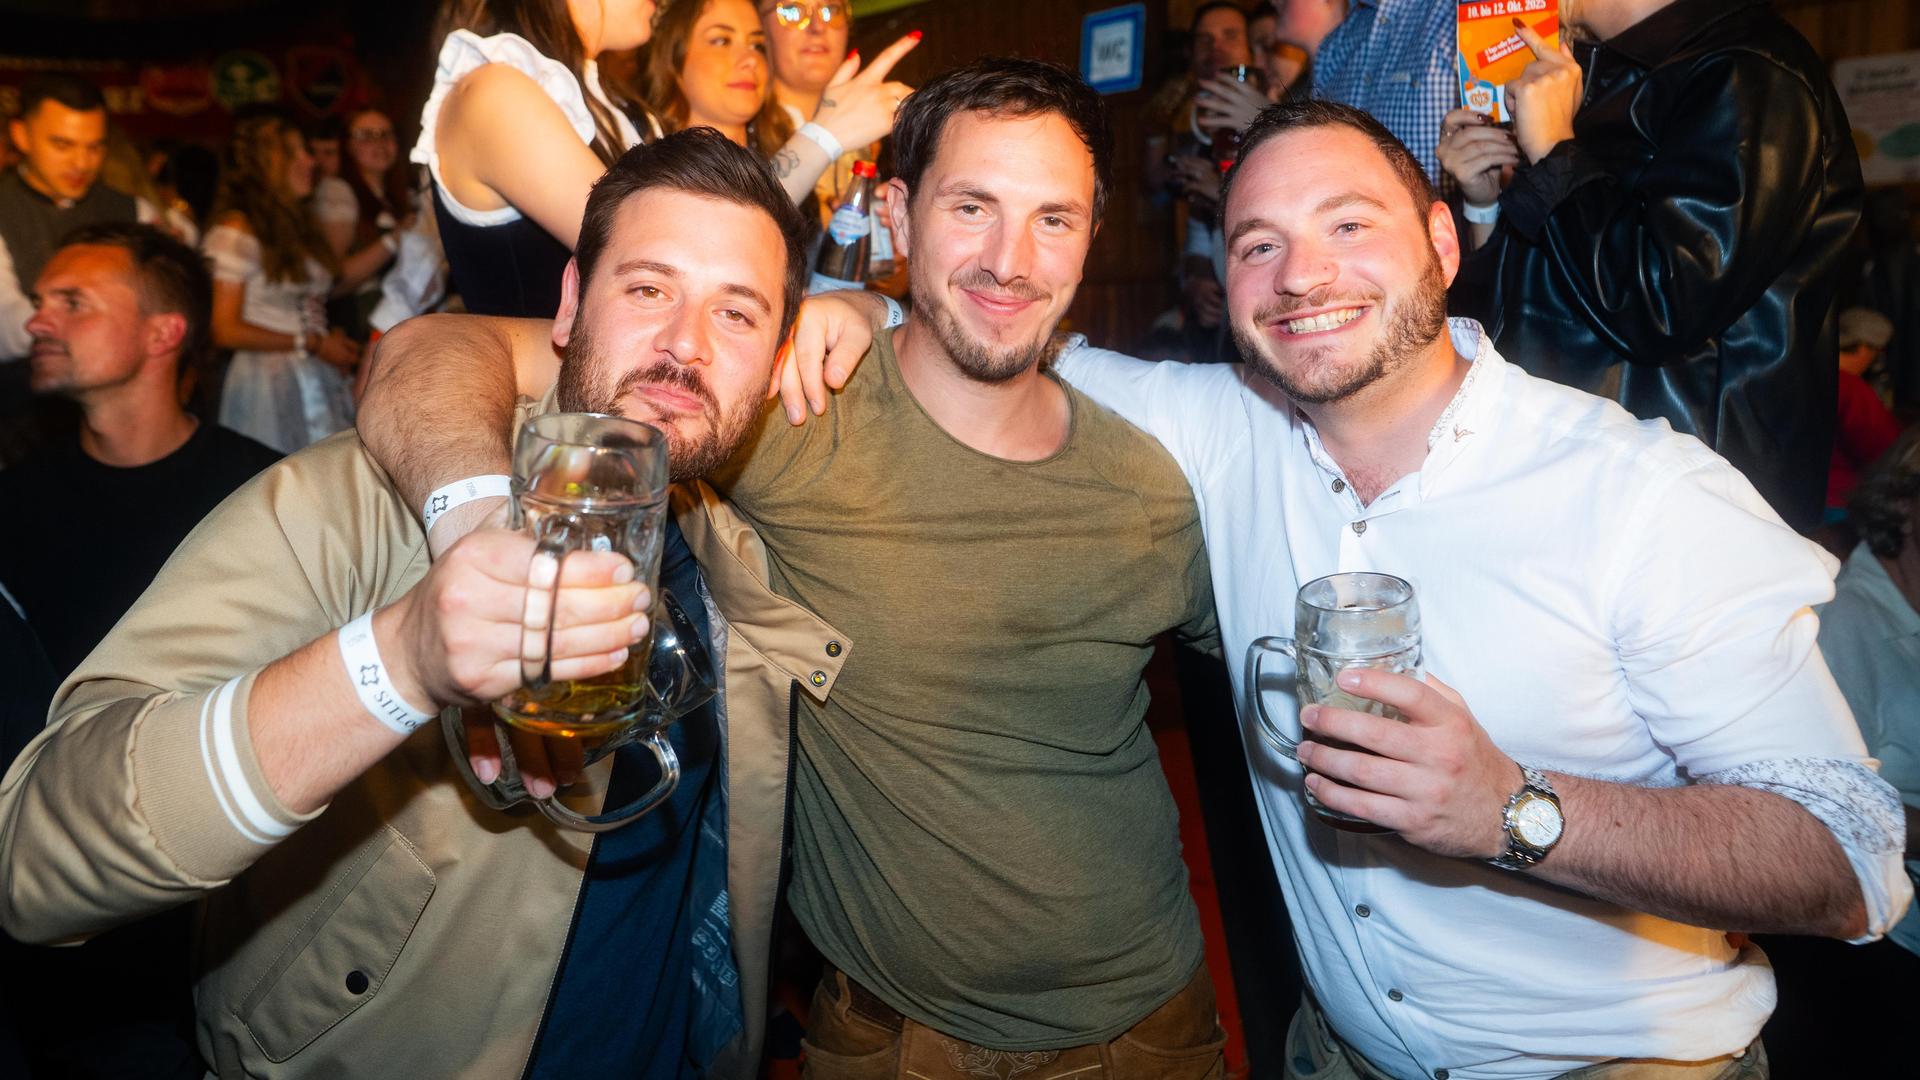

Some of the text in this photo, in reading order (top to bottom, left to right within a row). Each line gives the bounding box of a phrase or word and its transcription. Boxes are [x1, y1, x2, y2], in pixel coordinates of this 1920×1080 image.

[1468, 0, 1546, 19] 10. bis 12. Okt. 2025
[1097, 37, 1127, 63] WC
